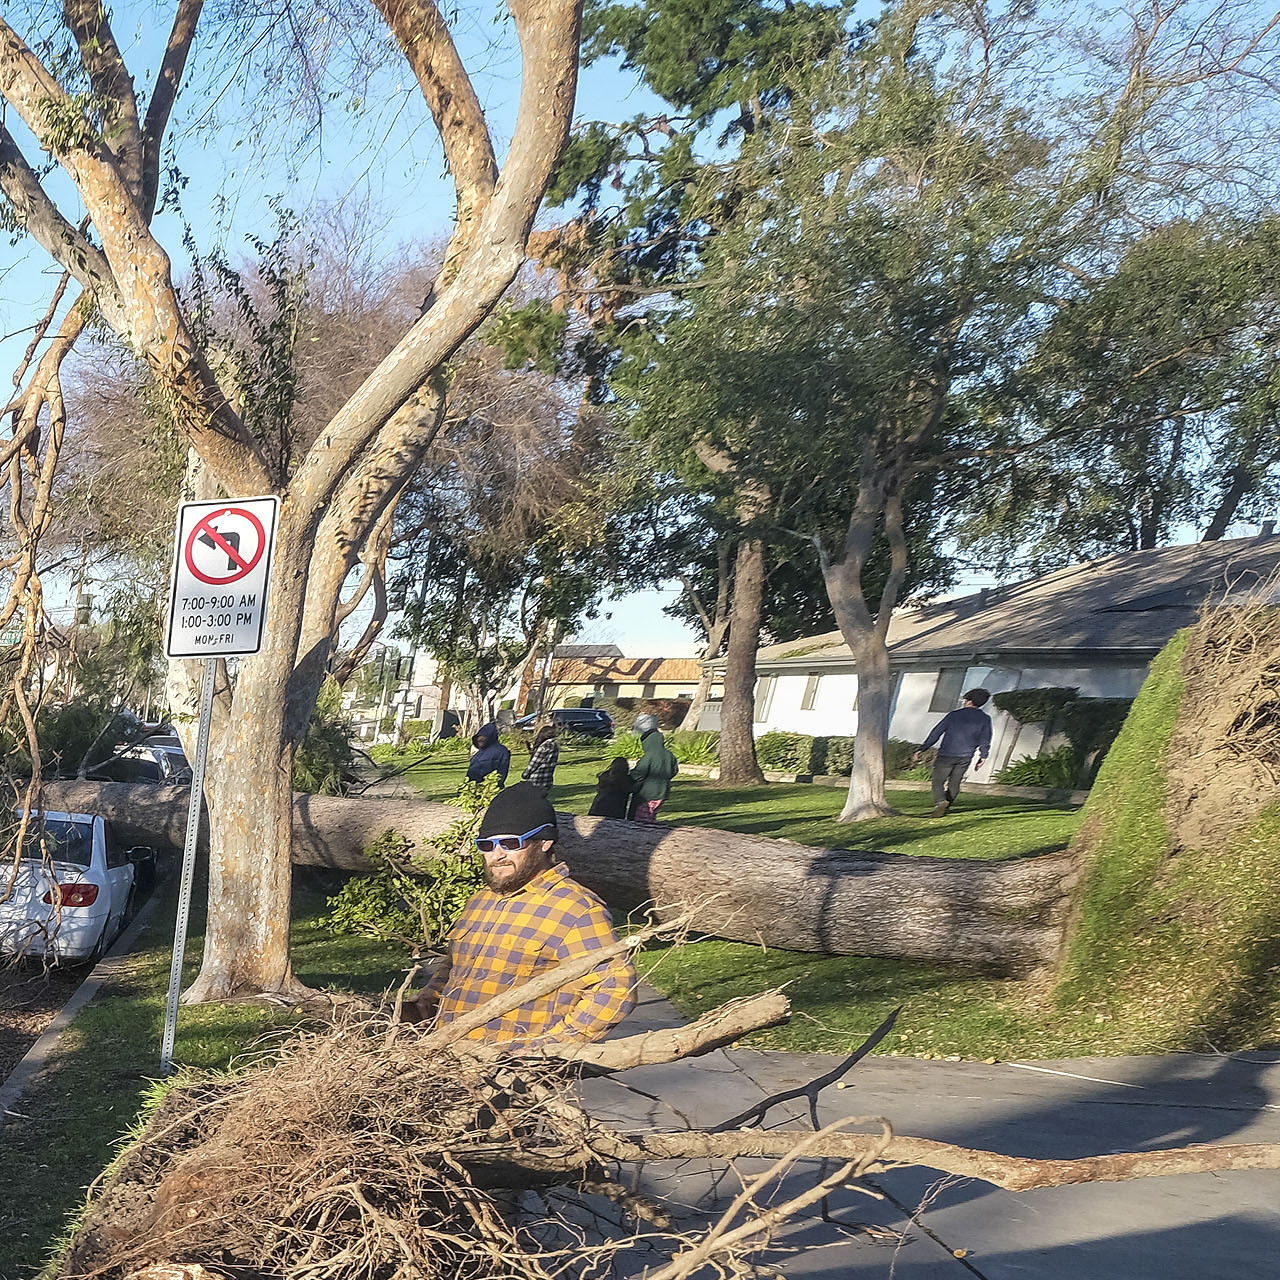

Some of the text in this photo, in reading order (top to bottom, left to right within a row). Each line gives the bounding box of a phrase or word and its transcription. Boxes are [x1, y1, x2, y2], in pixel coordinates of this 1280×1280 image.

[182, 594, 256, 610] 7:00-9:00 AM
[181, 612, 253, 628] 1:00-3:00 PM
